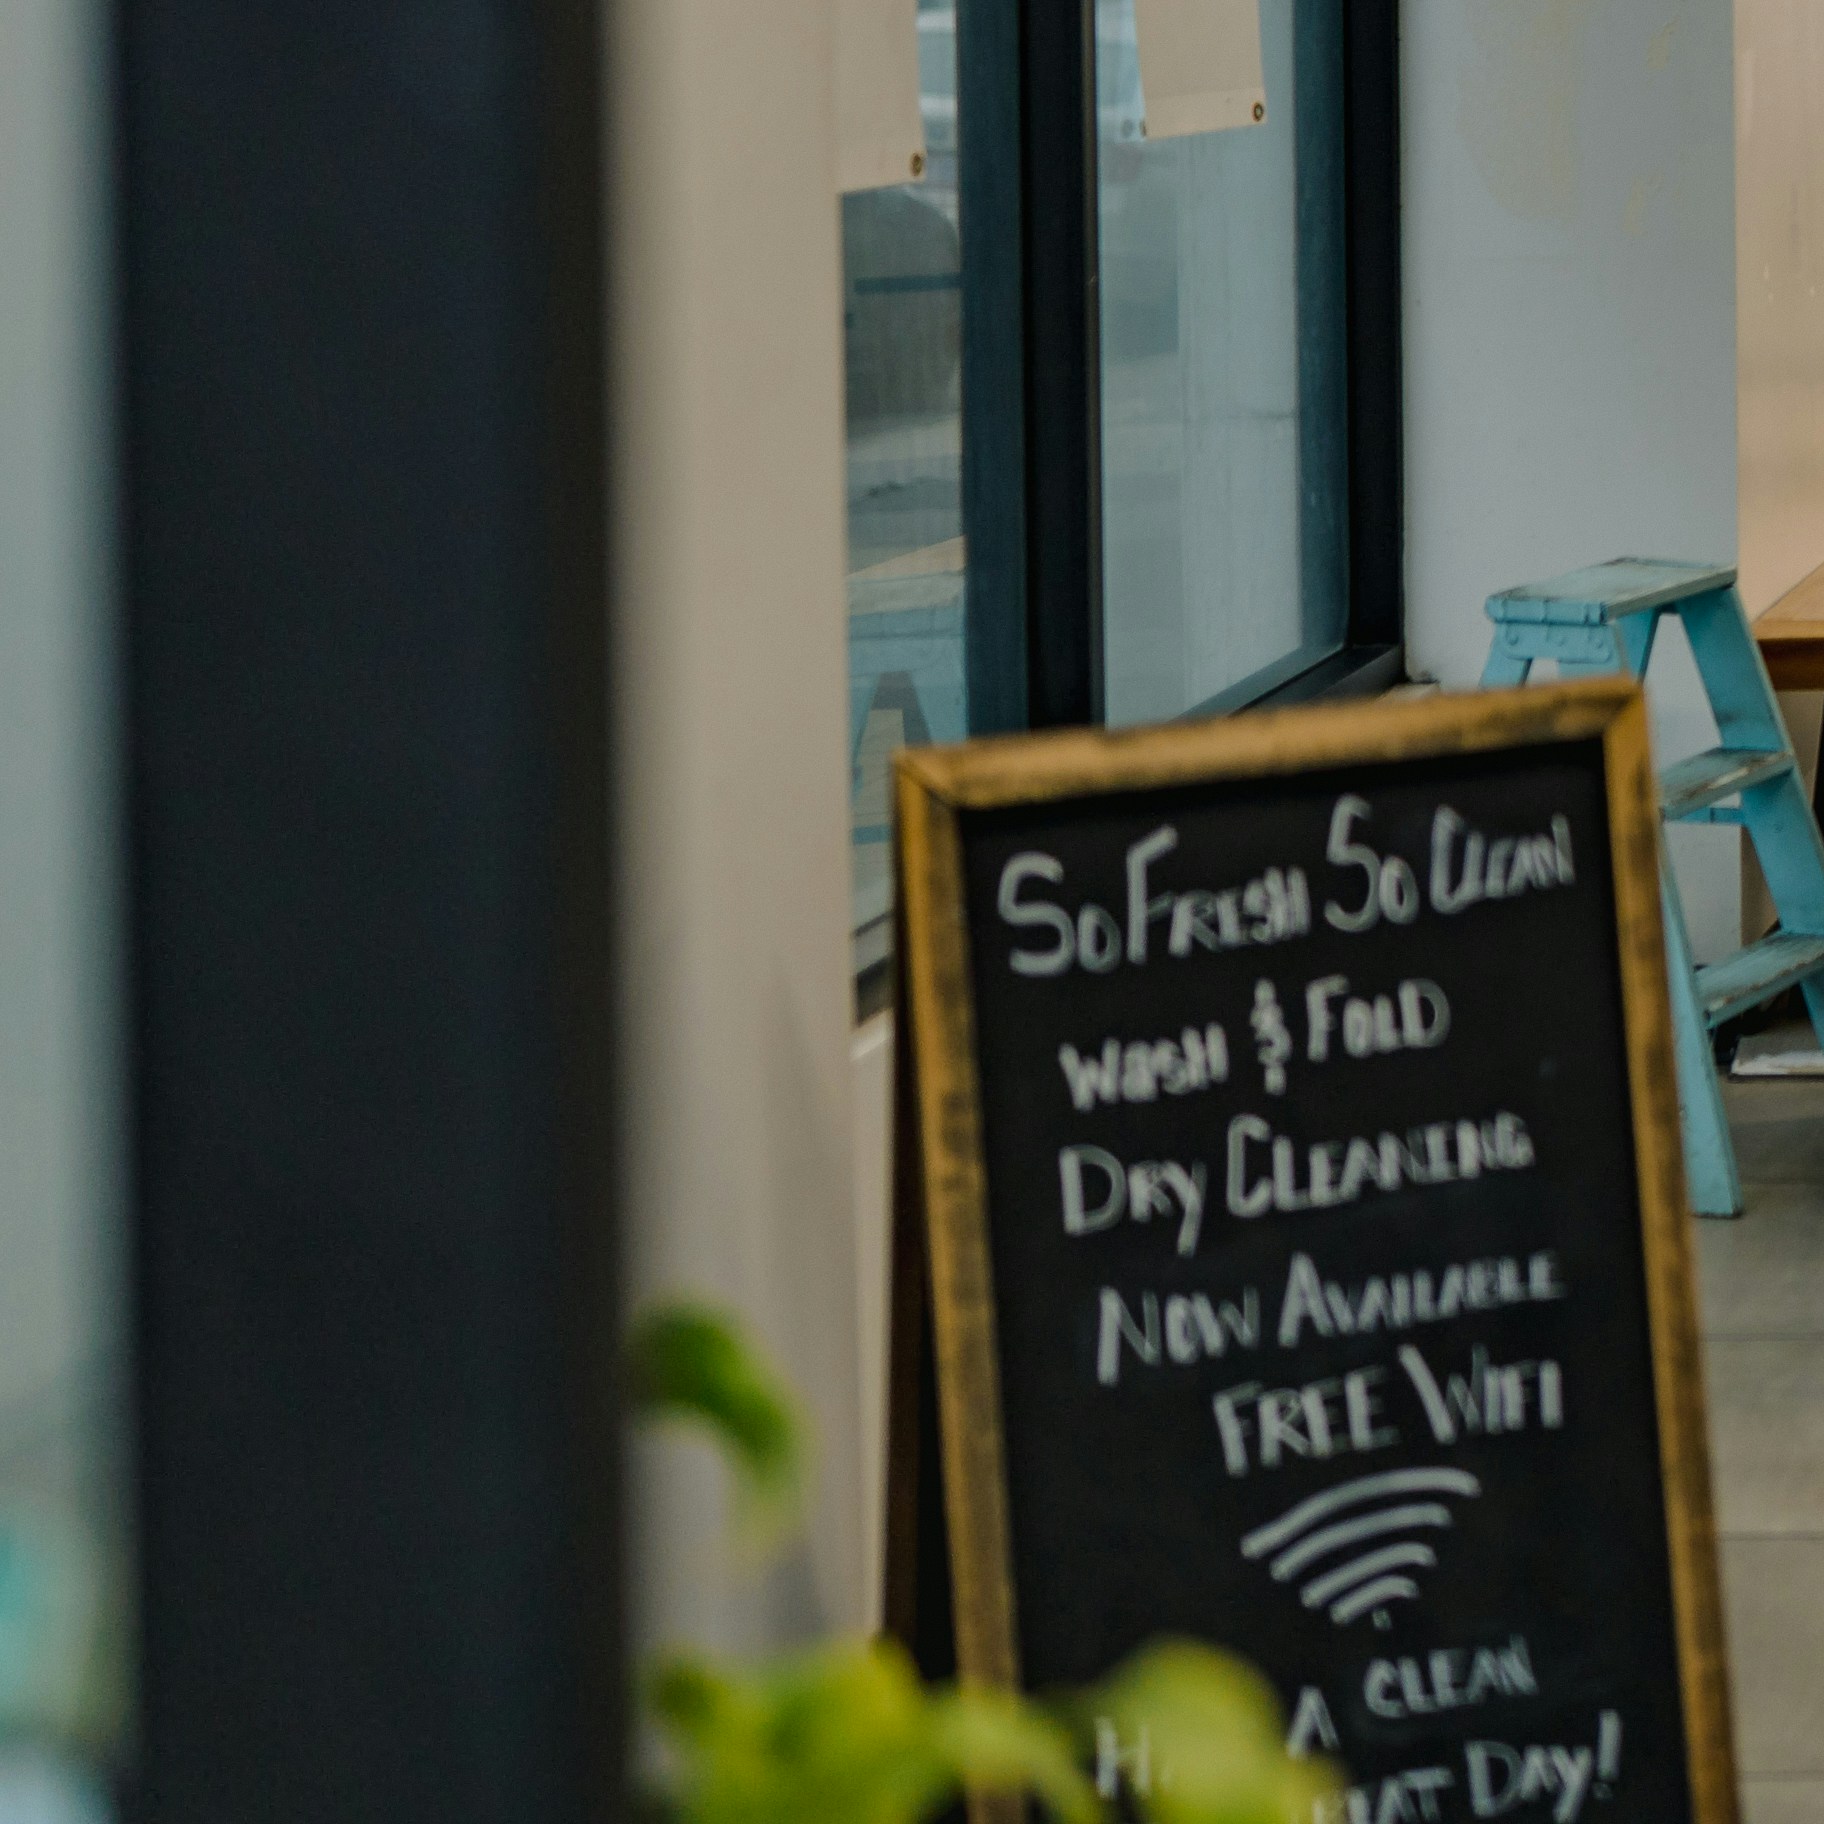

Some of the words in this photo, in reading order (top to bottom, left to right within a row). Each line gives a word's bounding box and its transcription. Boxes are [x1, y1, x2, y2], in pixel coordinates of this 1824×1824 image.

[998, 851, 1121, 974] SO
[1127, 823, 1311, 964] FRESH
[1324, 794, 1420, 933] SO
[1429, 805, 1576, 914] CLEAN
[1306, 974, 1451, 1062] FOLD
[1059, 1143, 1207, 1258] DRY
[1226, 1110, 1535, 1218] CLEANING
[1097, 1285, 1260, 1388] NOW
[1277, 1249, 1566, 1348] AVAILABLE
[1212, 1363, 1401, 1477] FREE
[1363, 1632, 1540, 1719] CLEAN
[1464, 1708, 1623, 1824] DAY!
